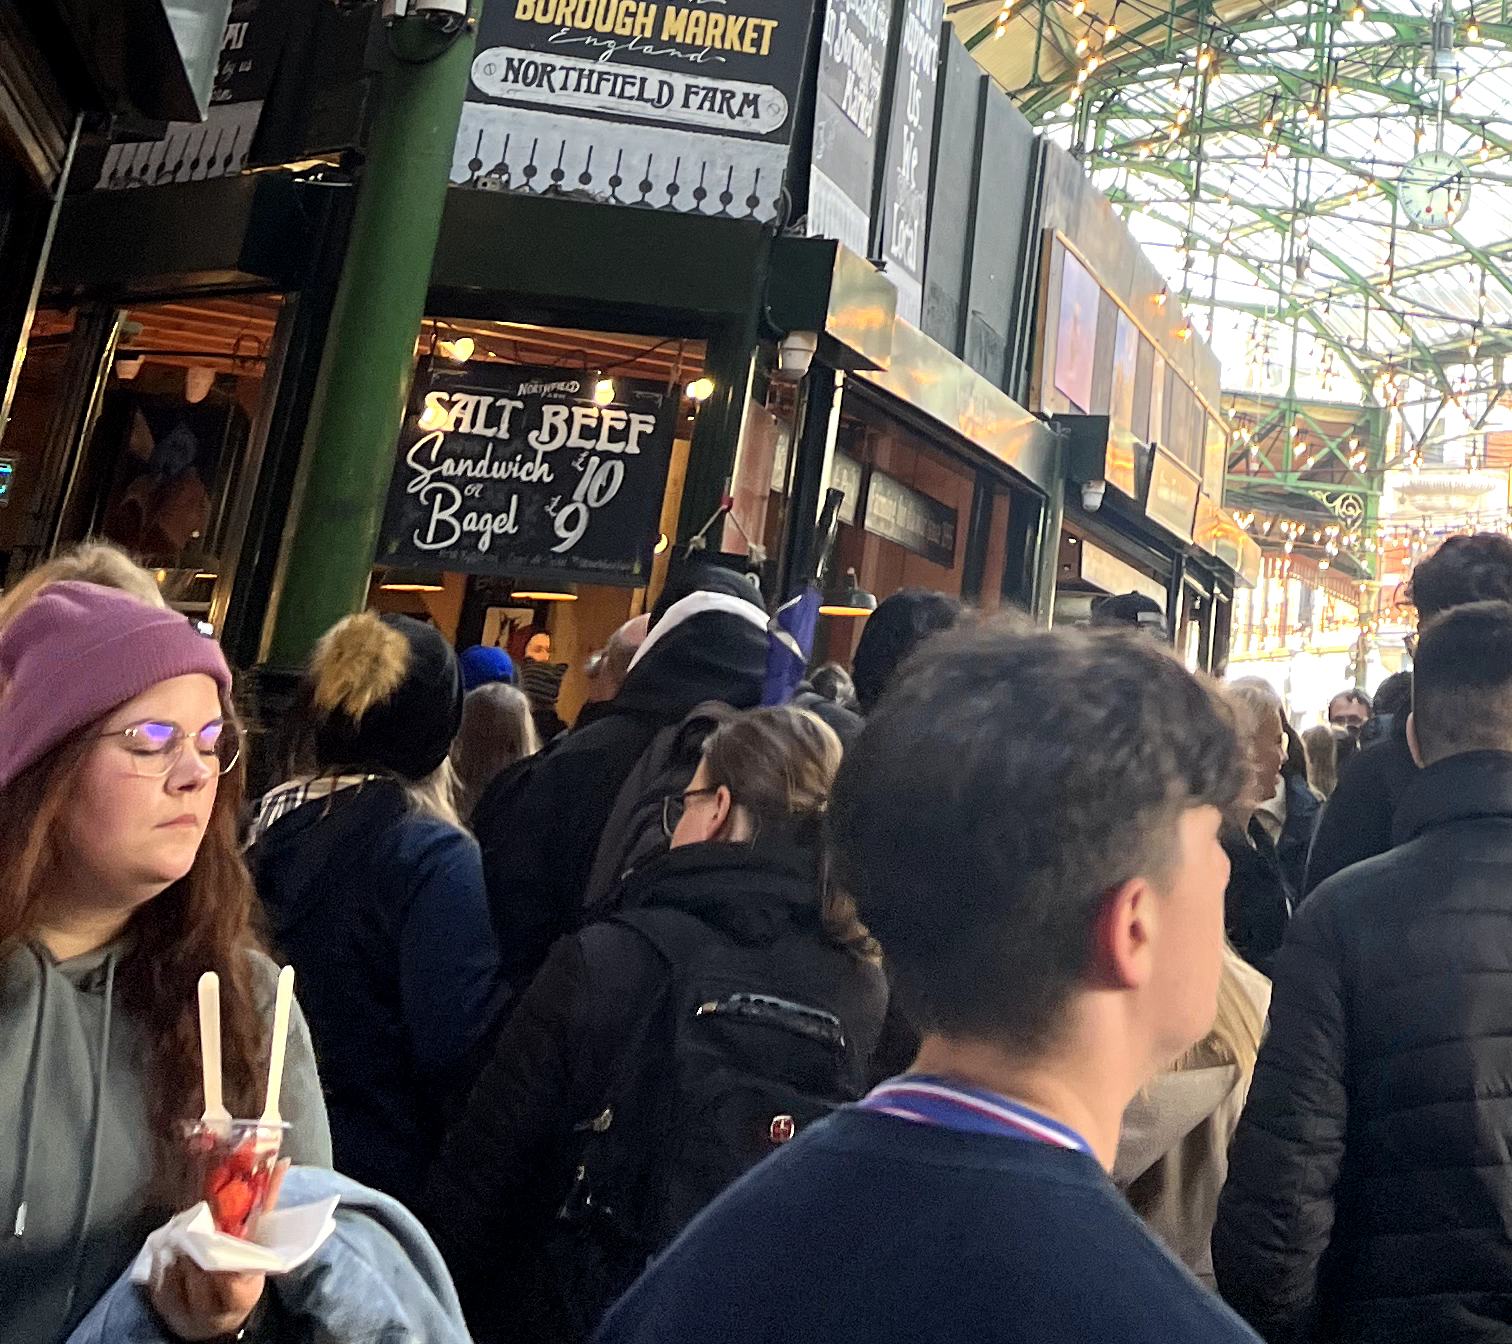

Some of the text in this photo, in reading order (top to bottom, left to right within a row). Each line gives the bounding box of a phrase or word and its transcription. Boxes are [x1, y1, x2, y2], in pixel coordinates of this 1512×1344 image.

[547, 27, 727, 63] England
[660, 9, 779, 56] MARKET
[501, 56, 762, 119] NORTHFIELD FARM
[419, 391, 656, 455] SALT BEEF
[406, 431, 555, 495] Sandwich
[463, 482, 485, 499] or
[413, 481, 519, 554] Bagel
